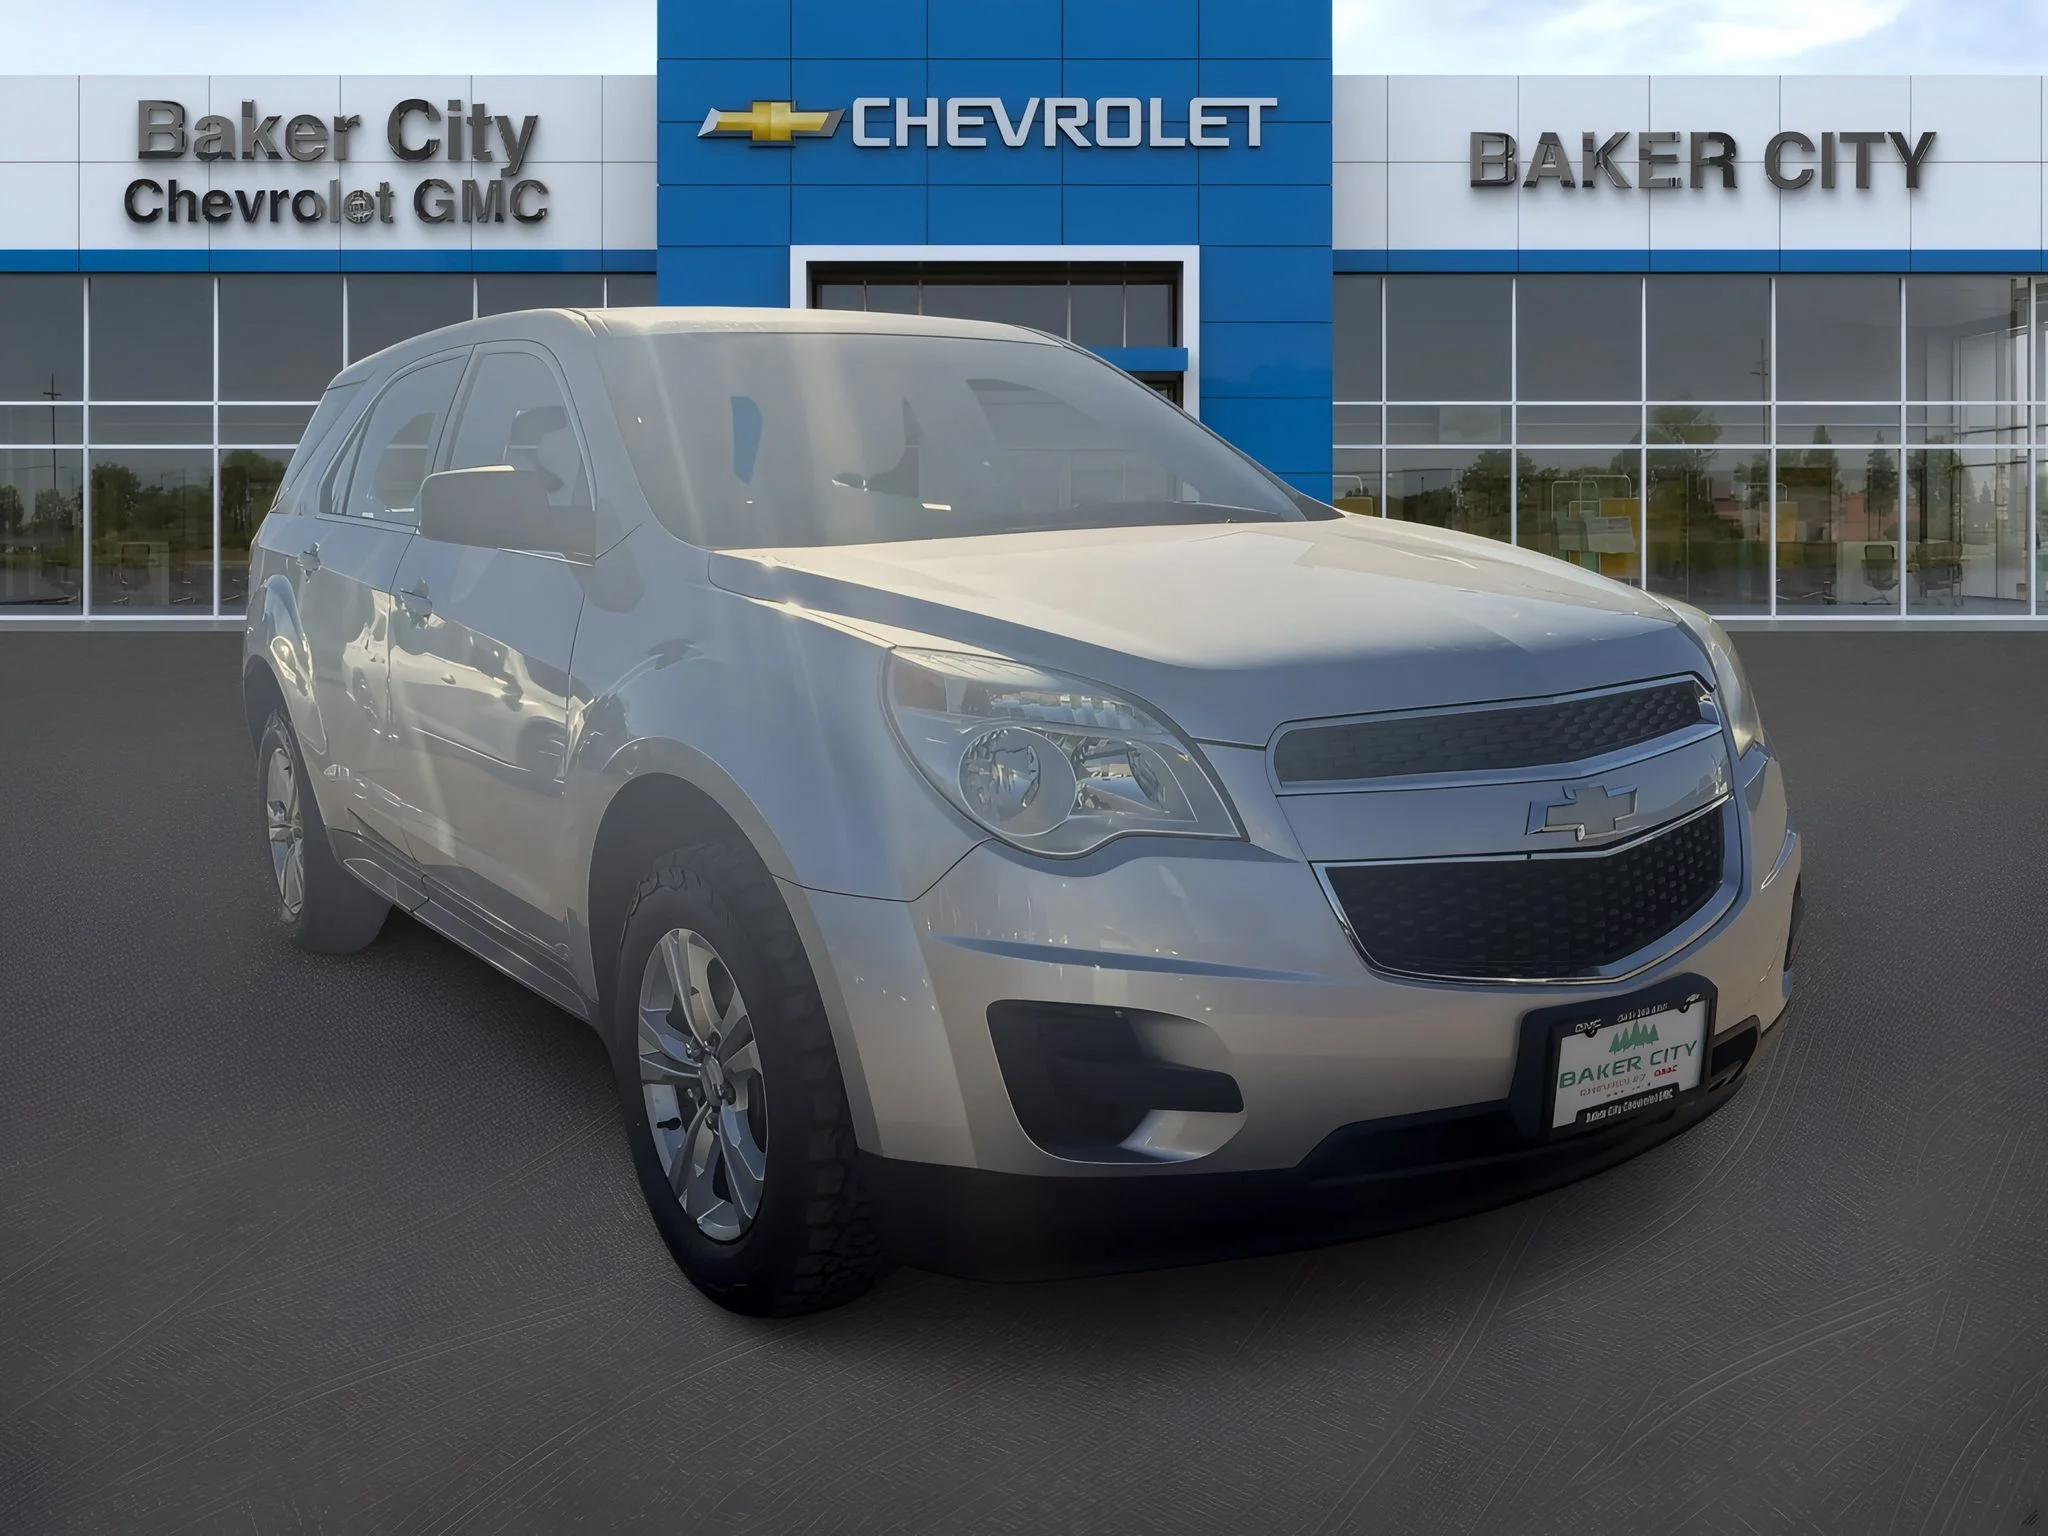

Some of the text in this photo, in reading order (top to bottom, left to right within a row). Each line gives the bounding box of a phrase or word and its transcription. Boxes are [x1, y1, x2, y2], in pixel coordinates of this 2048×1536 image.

[138, 99, 539, 177] Baker City
[853, 97, 1278, 147] CHEVROLET
[1470, 131, 1937, 189] BAKER CITY
[414, 178, 548, 224] GMC
[1559, 1056, 1642, 1088] BAKER
[1650, 1040, 1698, 1065] CITY
